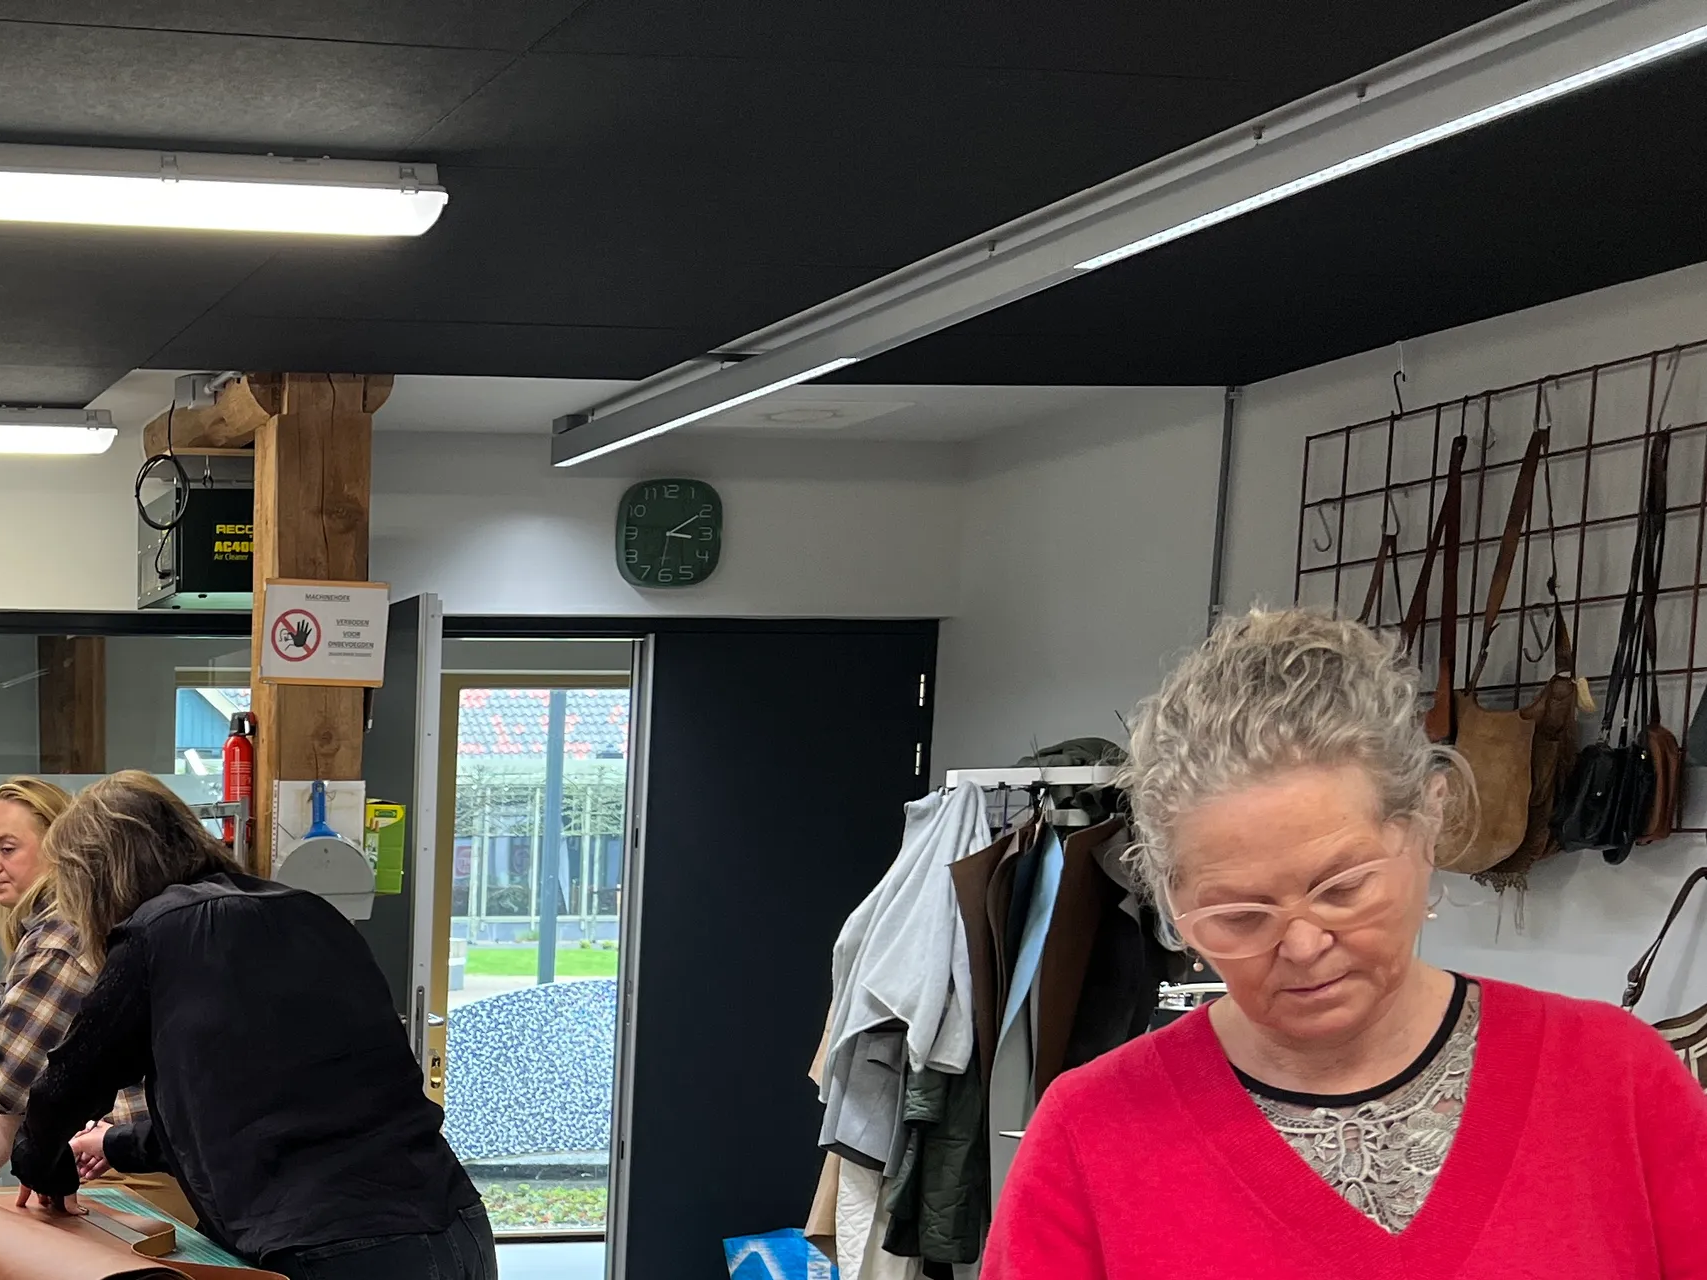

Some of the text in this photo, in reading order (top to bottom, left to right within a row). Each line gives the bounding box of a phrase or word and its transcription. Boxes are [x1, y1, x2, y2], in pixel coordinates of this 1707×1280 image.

[644, 487, 657, 501] 11
[663, 484, 680, 499] 12
[690, 486, 695, 499] 1
[629, 504, 647, 518] 10
[699, 504, 713, 518] 2
[625, 526, 639, 540] 9
[698, 526, 713, 541] 3
[625, 549, 638, 564] 8
[695, 550, 710, 563] 4
[640, 565, 652, 580] 7
[657, 568, 673, 583] 6
[679, 565, 694, 580] 5
[336, 619, 370, 628] VERBODEN
[342, 631, 361, 639] VOOR
[327, 641, 375, 650] ONBEVOEGDEN
